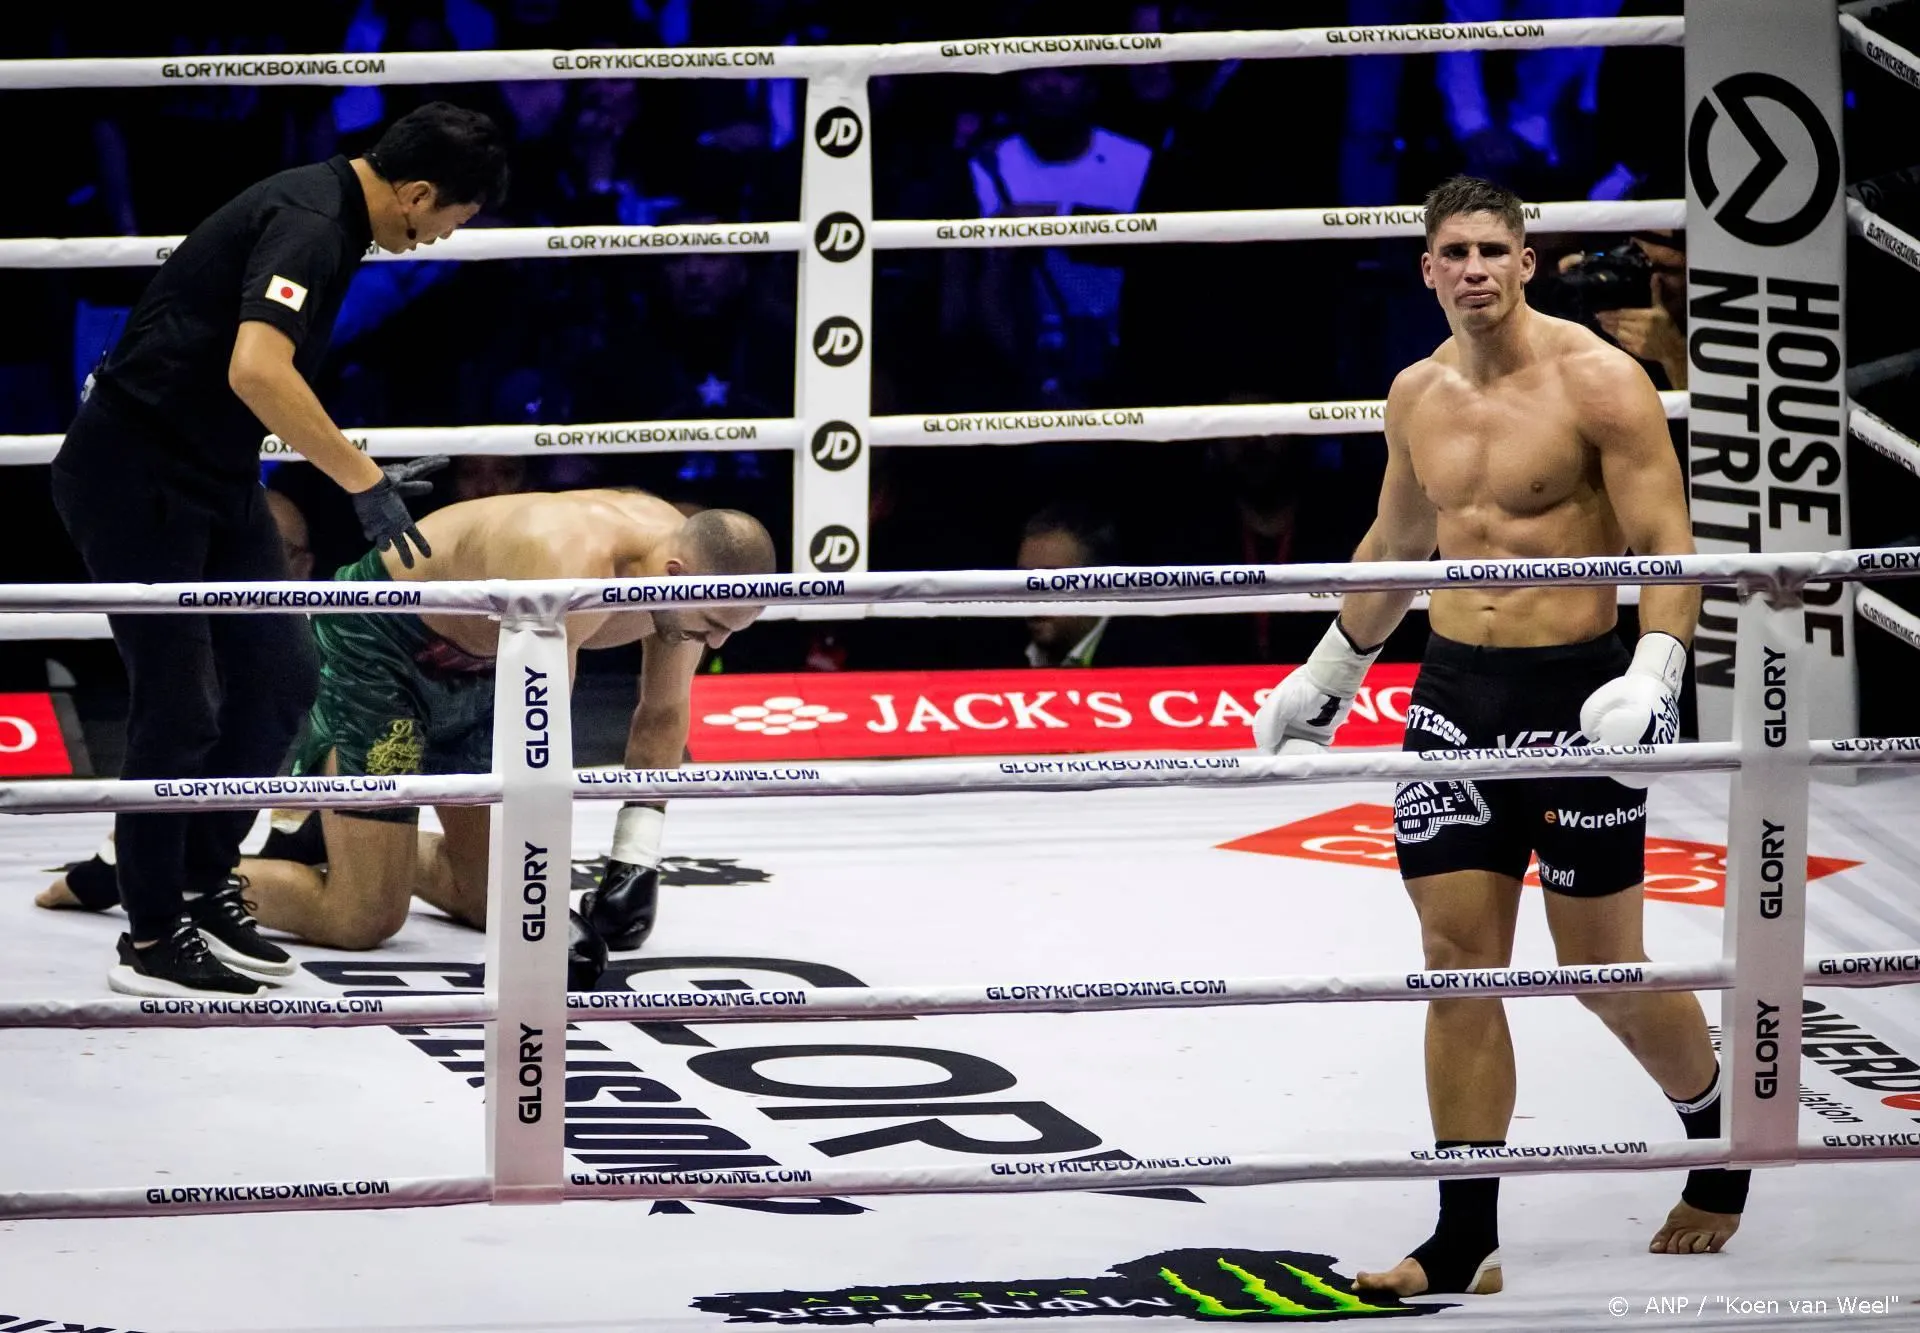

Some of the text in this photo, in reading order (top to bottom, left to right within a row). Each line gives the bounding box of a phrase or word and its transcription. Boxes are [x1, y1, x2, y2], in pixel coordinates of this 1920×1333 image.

[1326, 24, 1544, 45] GLORYKICKBOXING.COM
[940, 37, 1162, 58] GLORYKICKBOXING.COM
[162, 59, 386, 79] GLORYKICKBOXING.COM
[552, 51, 775, 71] GLORYKICKBOXING.COM
[820, 119, 859, 147] JD
[547, 230, 770, 252] GLORYKICKBOXING.COM
[819, 223, 860, 252] JD
[936, 218, 1157, 241] GLORYKICKBOXING.COM
[818, 327, 859, 356] JD
[1766, 278, 1844, 537] HOUSE
[923, 411, 1144, 434] GLORYKICKBOXING.COM
[535, 425, 757, 448] GLORYKICKBOXING.COM
[816, 432, 857, 460] JD
[1689, 268, 1762, 690] NUTRITON
[816, 537, 856, 565] JD
[1026, 568, 1267, 591] GLORYKICKBOXING.COM
[1446, 559, 1683, 581] GLORYKICKBOXING.COM
[178, 589, 421, 609] GLORYKICKBOXING.COM
[602, 579, 845, 604] GLORYKICKBOXING.COM
[1763, 646, 1787, 748] GLORY
[524, 665, 548, 770] GLORY
[865, 690, 1135, 734] JACK'S
[154, 776, 398, 798] GLORYKICKBOXING.COM
[577, 768, 821, 787] GLORYKICKBOXING.COM
[1398, 796, 1456, 818] DOODLE
[1544, 802, 1647, 829] eWarehou
[1760, 819, 1785, 920] GLORY
[522, 840, 546, 943] GLORY
[1405, 965, 1644, 990] GLORYKICKBOXING.COM
[565, 990, 807, 1010] GLORYKICKBOXING.COM
[985, 979, 1227, 1002] GLORYKICKBOXING.COM
[140, 998, 384, 1016] GLORYKICKBOXING.COM
[1754, 1000, 1780, 1101] GLORY
[518, 1022, 543, 1125] GLORY
[1410, 1140, 1649, 1161] GLORYKICKBOXING.COM
[1823, 1133, 1920, 1147] GLORYKIC
[570, 1168, 812, 1187] GLORYKICKBOXING.COM
[990, 1155, 1232, 1177] GLORYKICKBOXING.COM
[146, 1178, 391, 1205] GLORYKICKBOXING.COM
